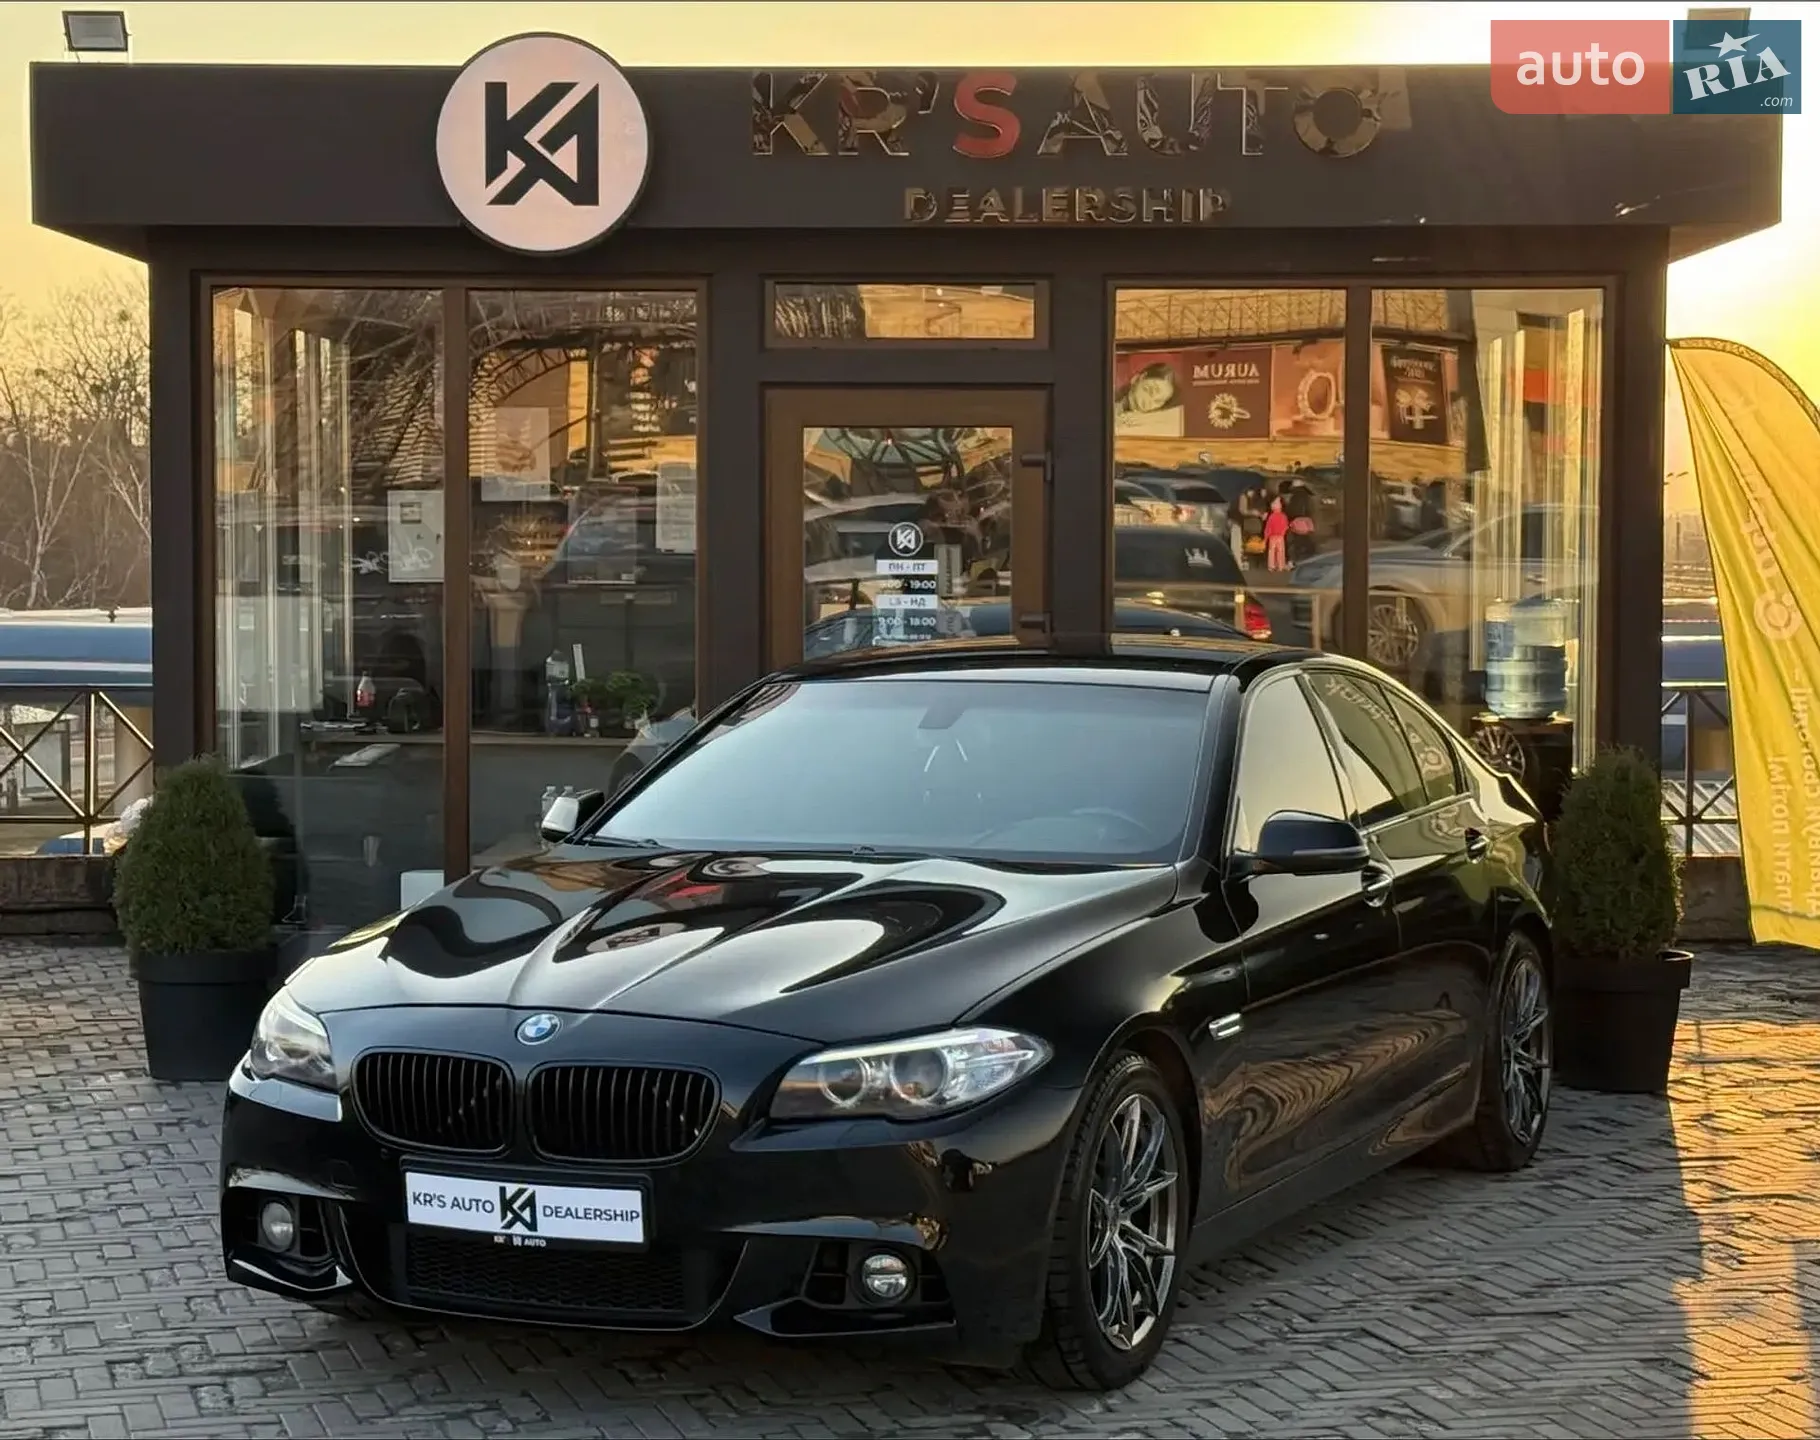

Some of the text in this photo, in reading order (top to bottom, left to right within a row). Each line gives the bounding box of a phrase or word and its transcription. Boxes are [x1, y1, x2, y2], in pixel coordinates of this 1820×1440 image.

[751, 69, 1383, 158] KR'S AUTO
[903, 186, 1230, 223] DEALERSHIP
[910, 580, 936, 589] 19:00
[910, 617, 936, 626] 18:00
[412, 1191, 495, 1214] KR'S AUTO
[542, 1204, 640, 1223] DEALERSHIP
